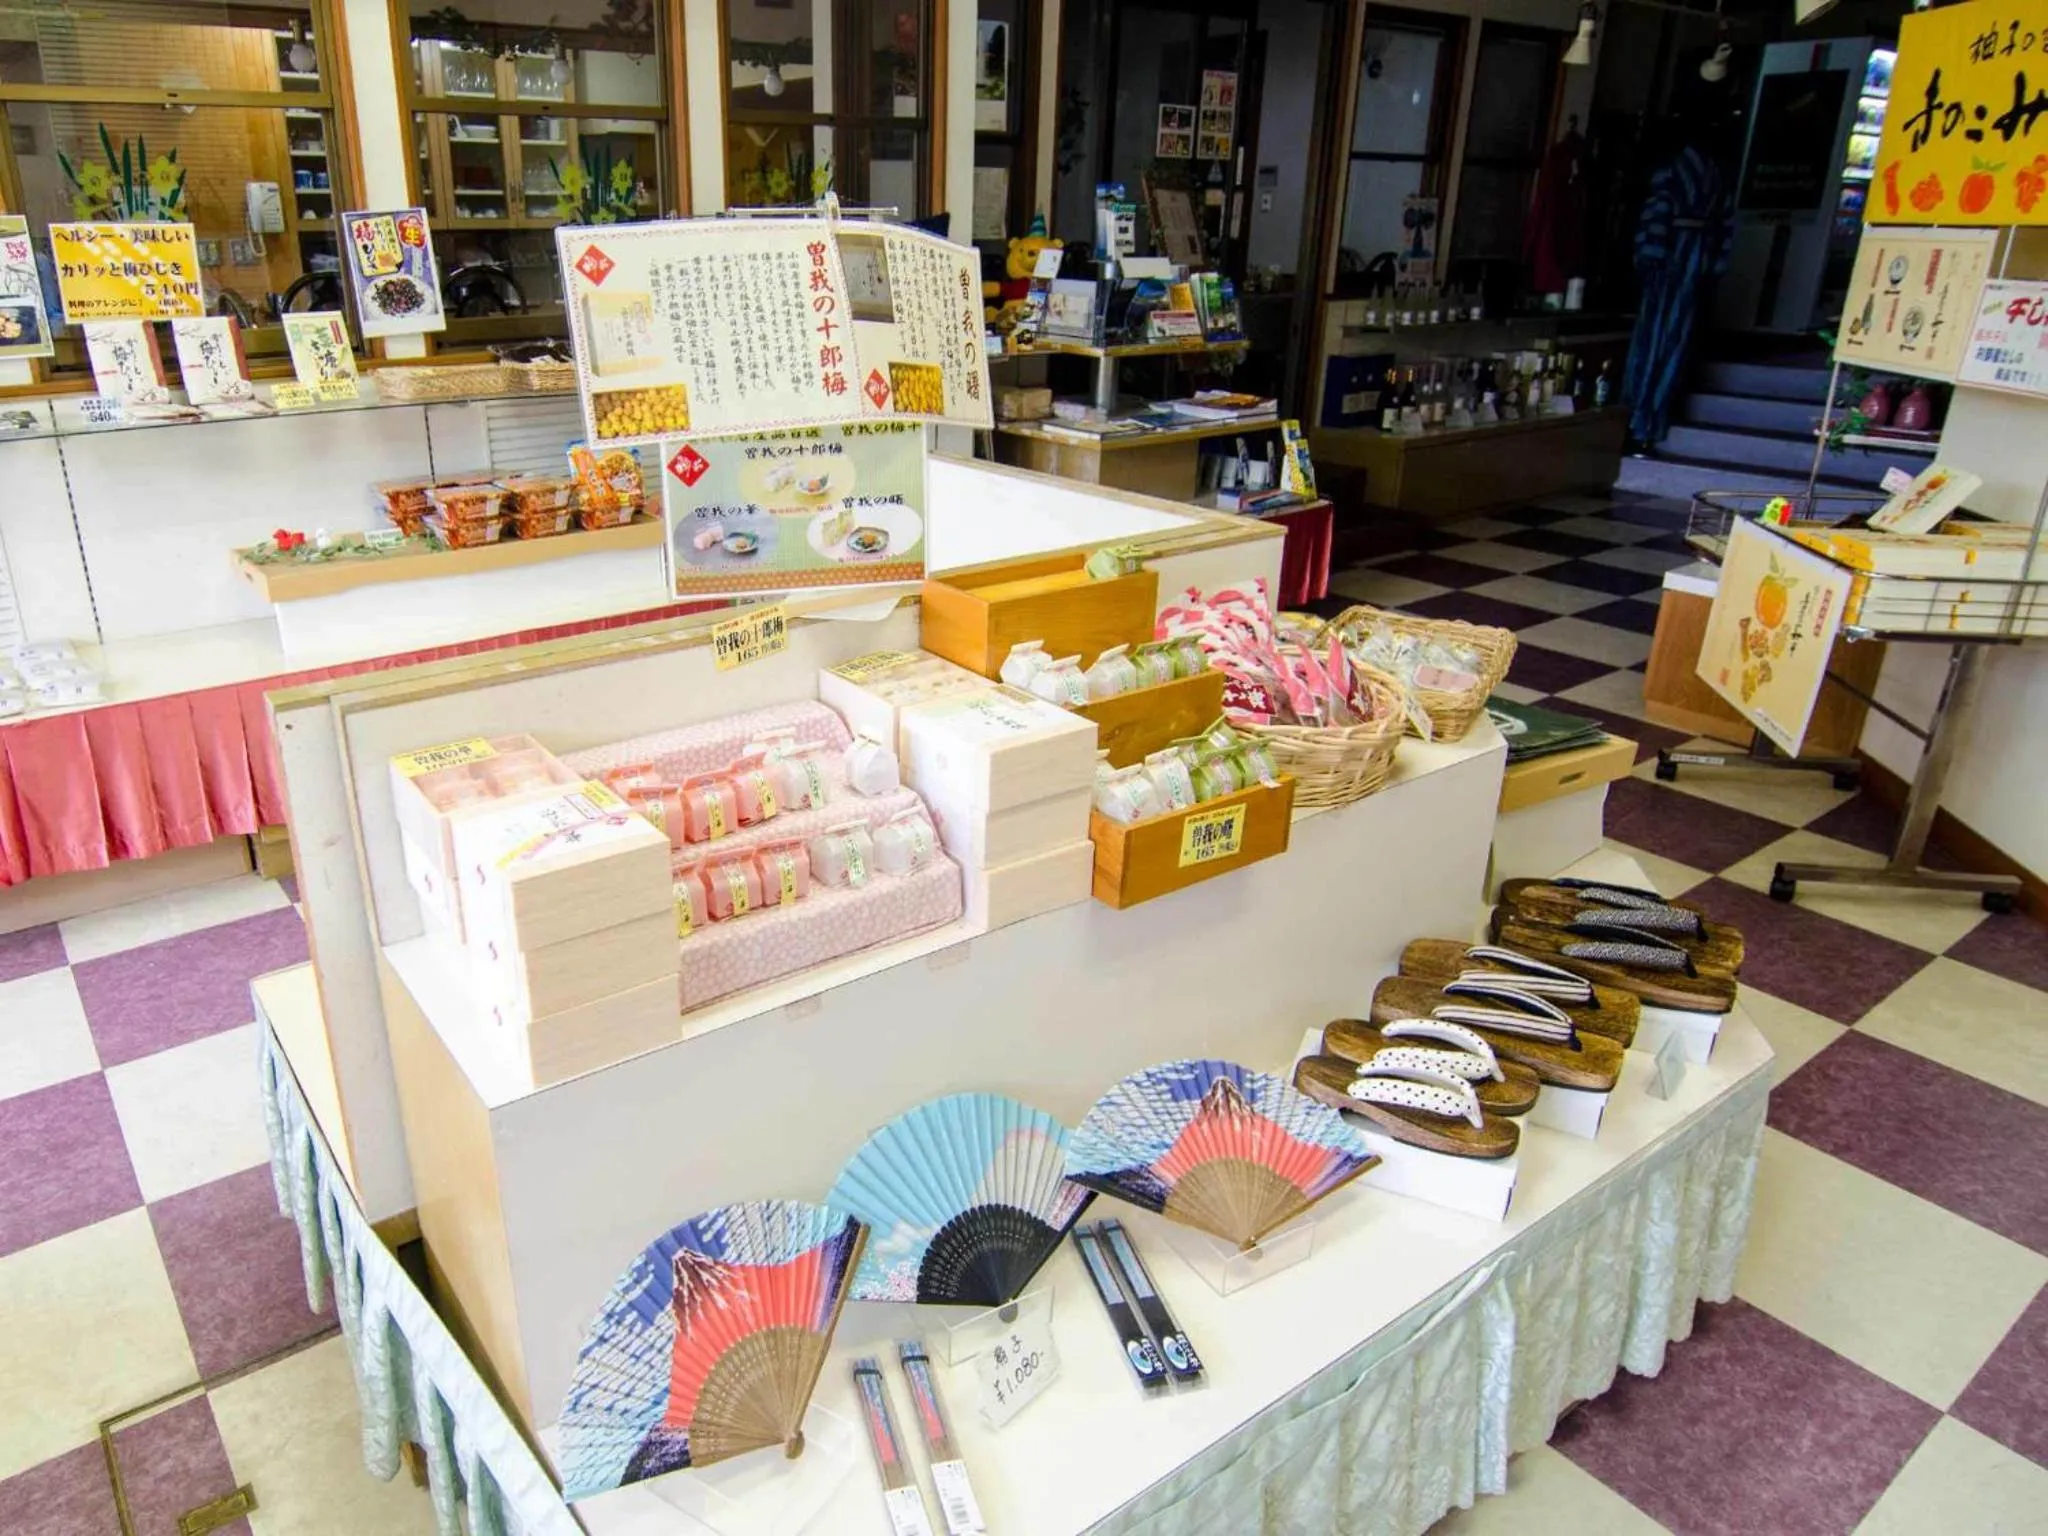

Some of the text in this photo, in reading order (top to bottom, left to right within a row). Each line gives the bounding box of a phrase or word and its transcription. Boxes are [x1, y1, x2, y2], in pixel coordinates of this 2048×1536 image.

[61, 262, 183, 277] カリッと梅ひじき
